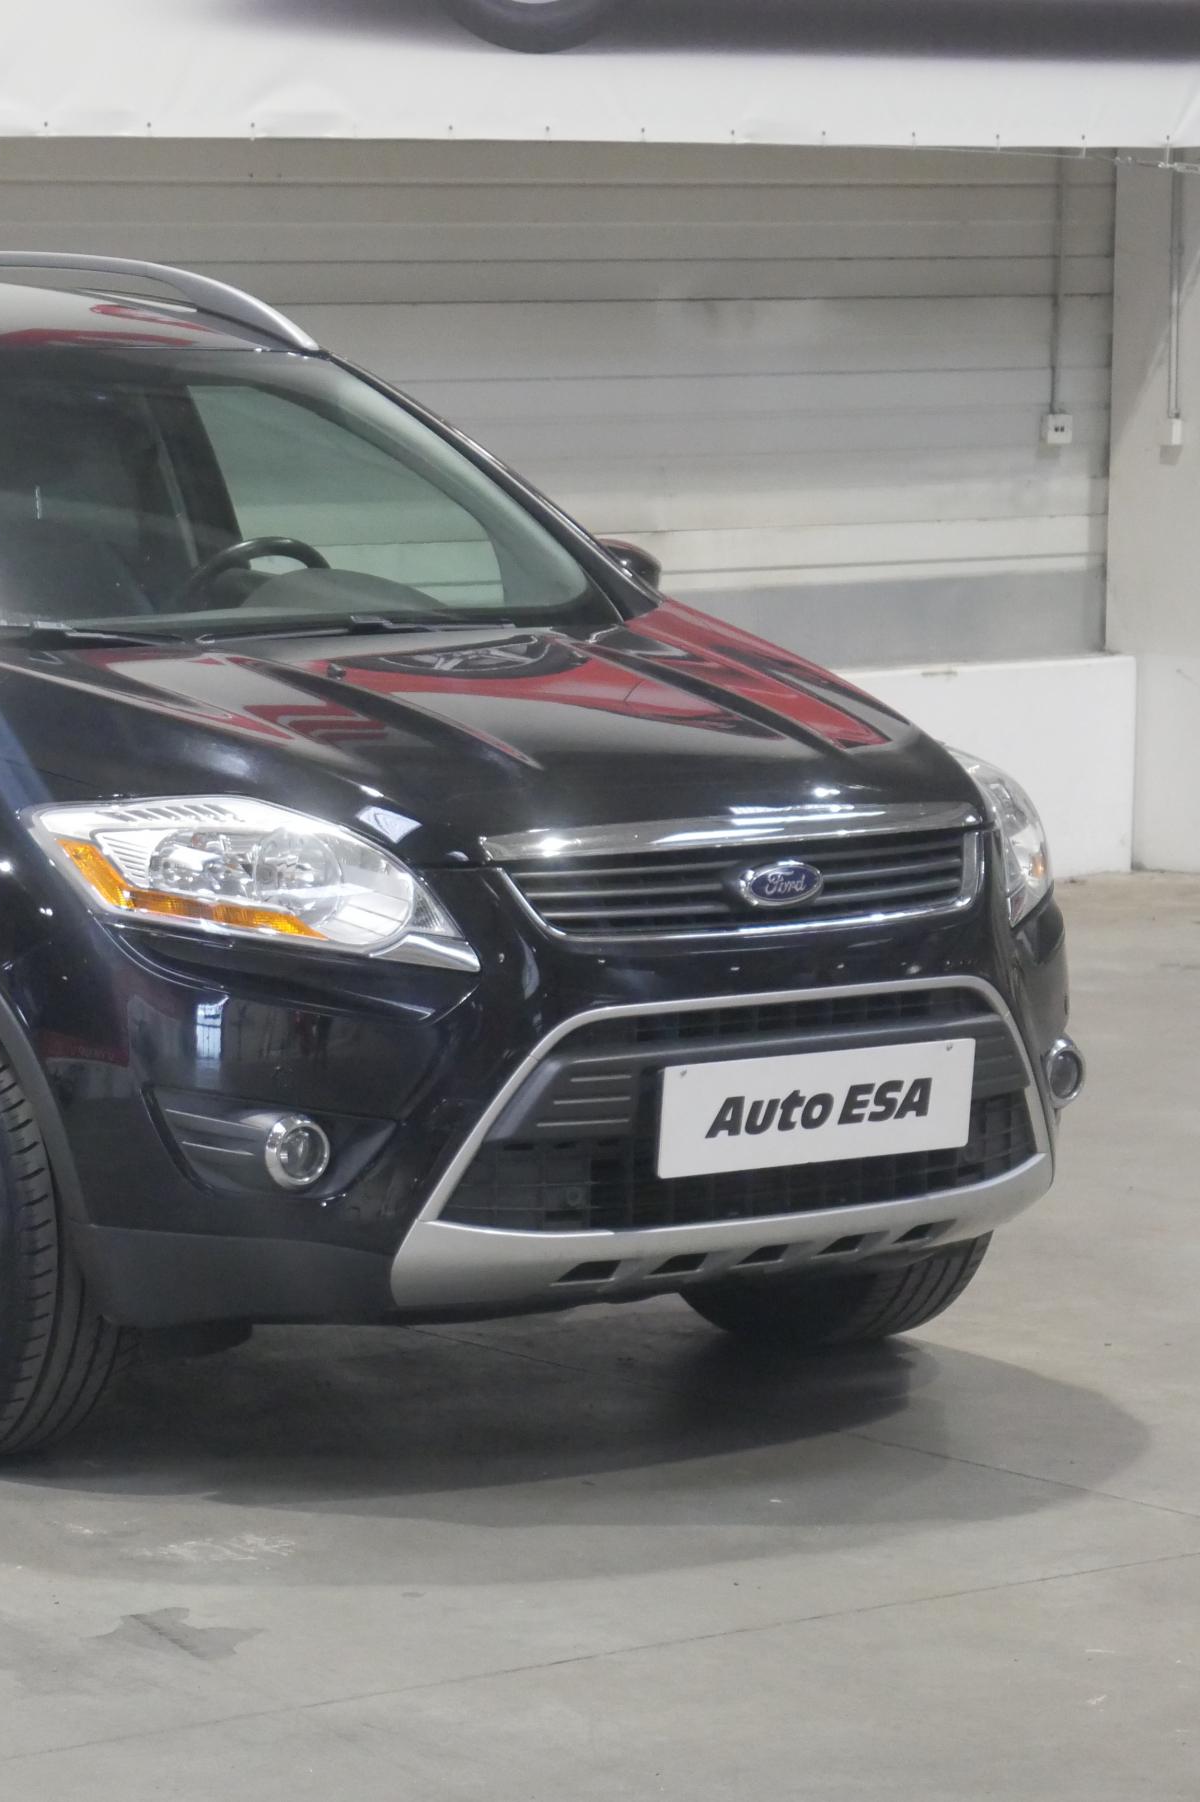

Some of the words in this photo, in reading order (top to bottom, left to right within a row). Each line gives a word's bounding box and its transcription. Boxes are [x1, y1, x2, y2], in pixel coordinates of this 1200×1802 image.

[765, 870, 806, 895] Ford
[705, 1090, 834, 1139] Auto
[837, 1077, 933, 1125] ESA
